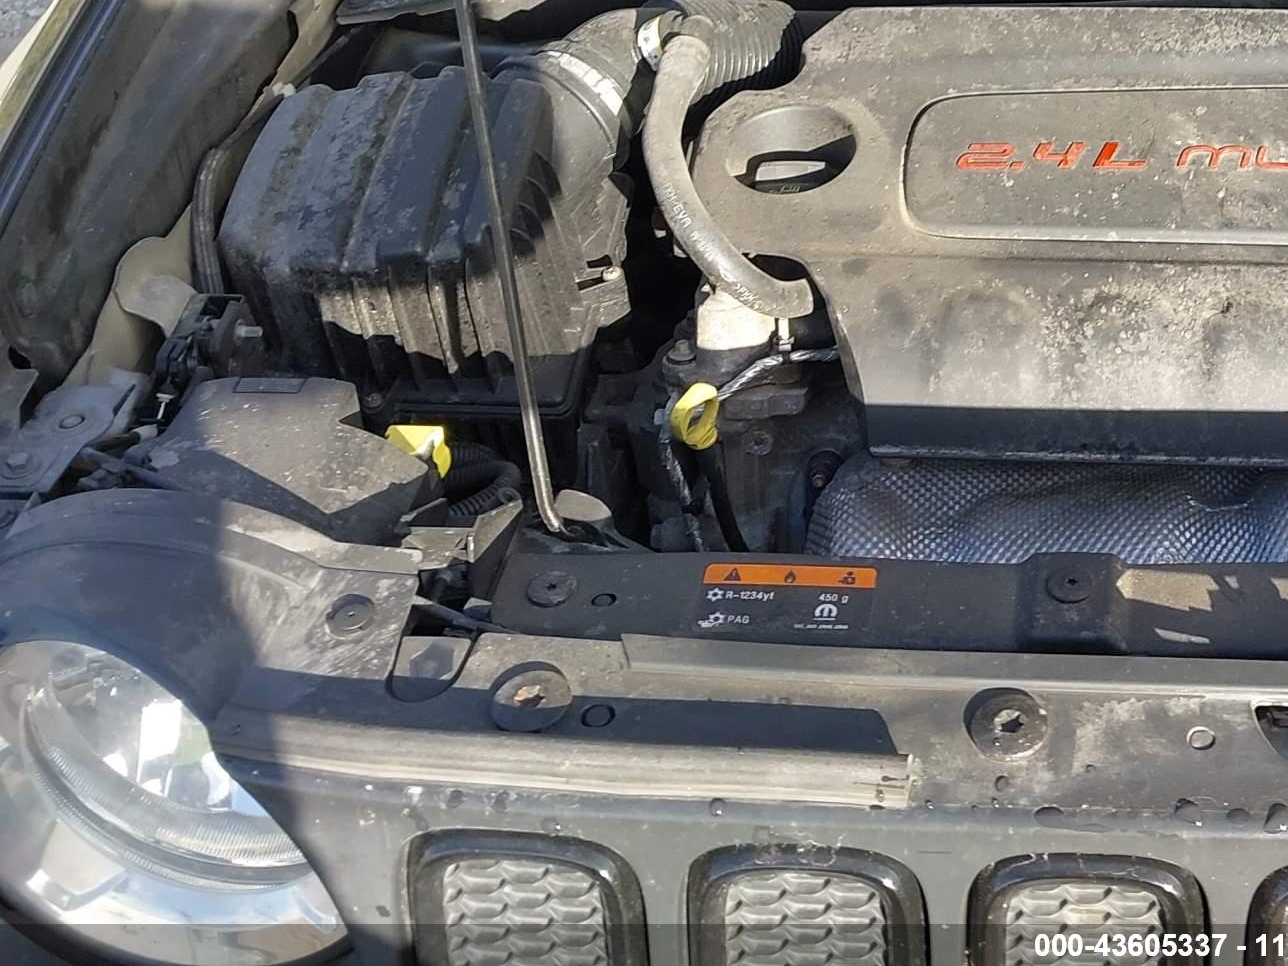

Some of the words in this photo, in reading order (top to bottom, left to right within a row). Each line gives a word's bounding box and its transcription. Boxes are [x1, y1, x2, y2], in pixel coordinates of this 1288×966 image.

[725, 590, 775, 602] R-1234yf
[818, 593, 838, 602] 450
[727, 615, 750, 624] PAG
